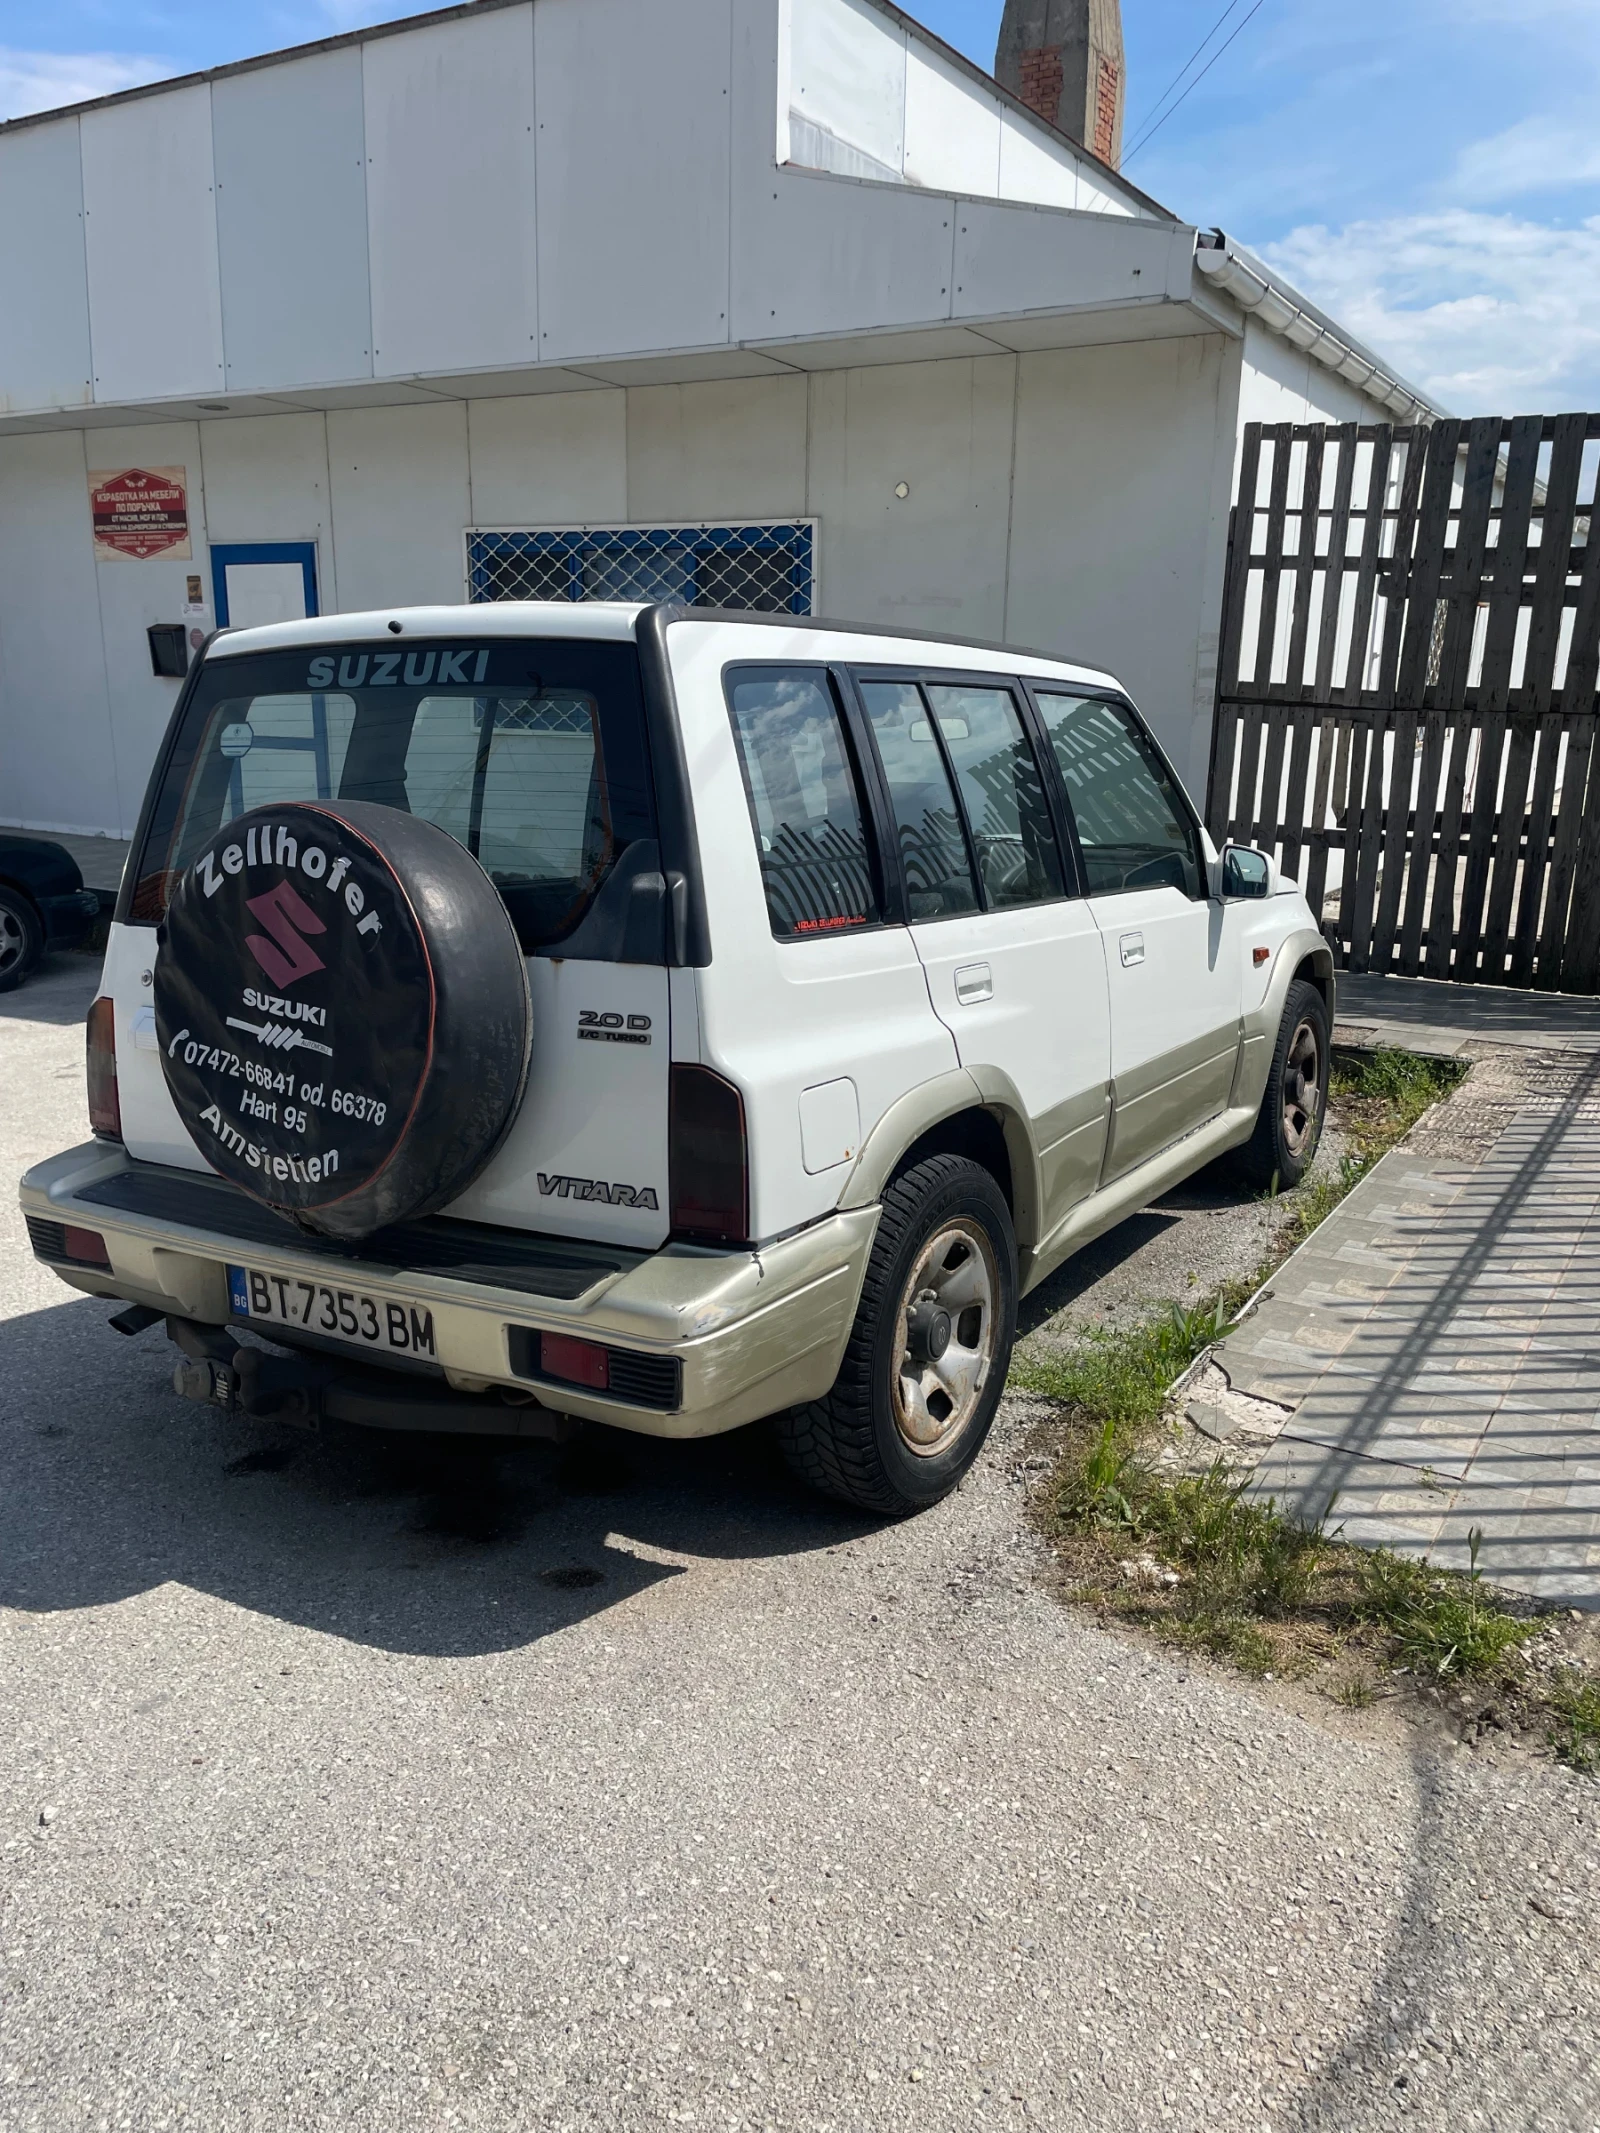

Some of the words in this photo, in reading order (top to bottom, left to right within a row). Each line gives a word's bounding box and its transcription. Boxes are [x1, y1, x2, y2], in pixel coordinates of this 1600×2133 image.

[97, 492, 138, 502] ИЗРАБОТКА
[139, 491, 149, 500] НА
[150, 490, 179, 500] МЕБЕЛИ
[116, 503, 126, 512] ПО
[127, 502, 161, 512] ПОРЪЧКА
[307, 650, 490, 687] SUZUKI
[196, 825, 383, 936] Zellhofer
[242, 988, 326, 1027] SUZUKI
[578, 1010, 625, 1028] 2.0
[627, 1014, 652, 1031] D
[301, 1039, 330, 1054] AUTOMOBILE
[580, 1030, 600, 1039] I/C
[604, 1032, 648, 1043] TURBO
[184, 1041, 295, 1096] 07472-66841
[300, 1083, 326, 1108] od.
[331, 1089, 387, 1126] 66378
[239, 1089, 277, 1123] Hart
[283, 1106, 307, 1133] 95
[199, 1104, 339, 1183] Amstetten
[537, 1172, 659, 1210] VITARA
[233, 1293, 247, 1308] BG
[250, 1270, 290, 1319] BT
[297, 1281, 380, 1341] 7353
[386, 1302, 435, 1356] BM
